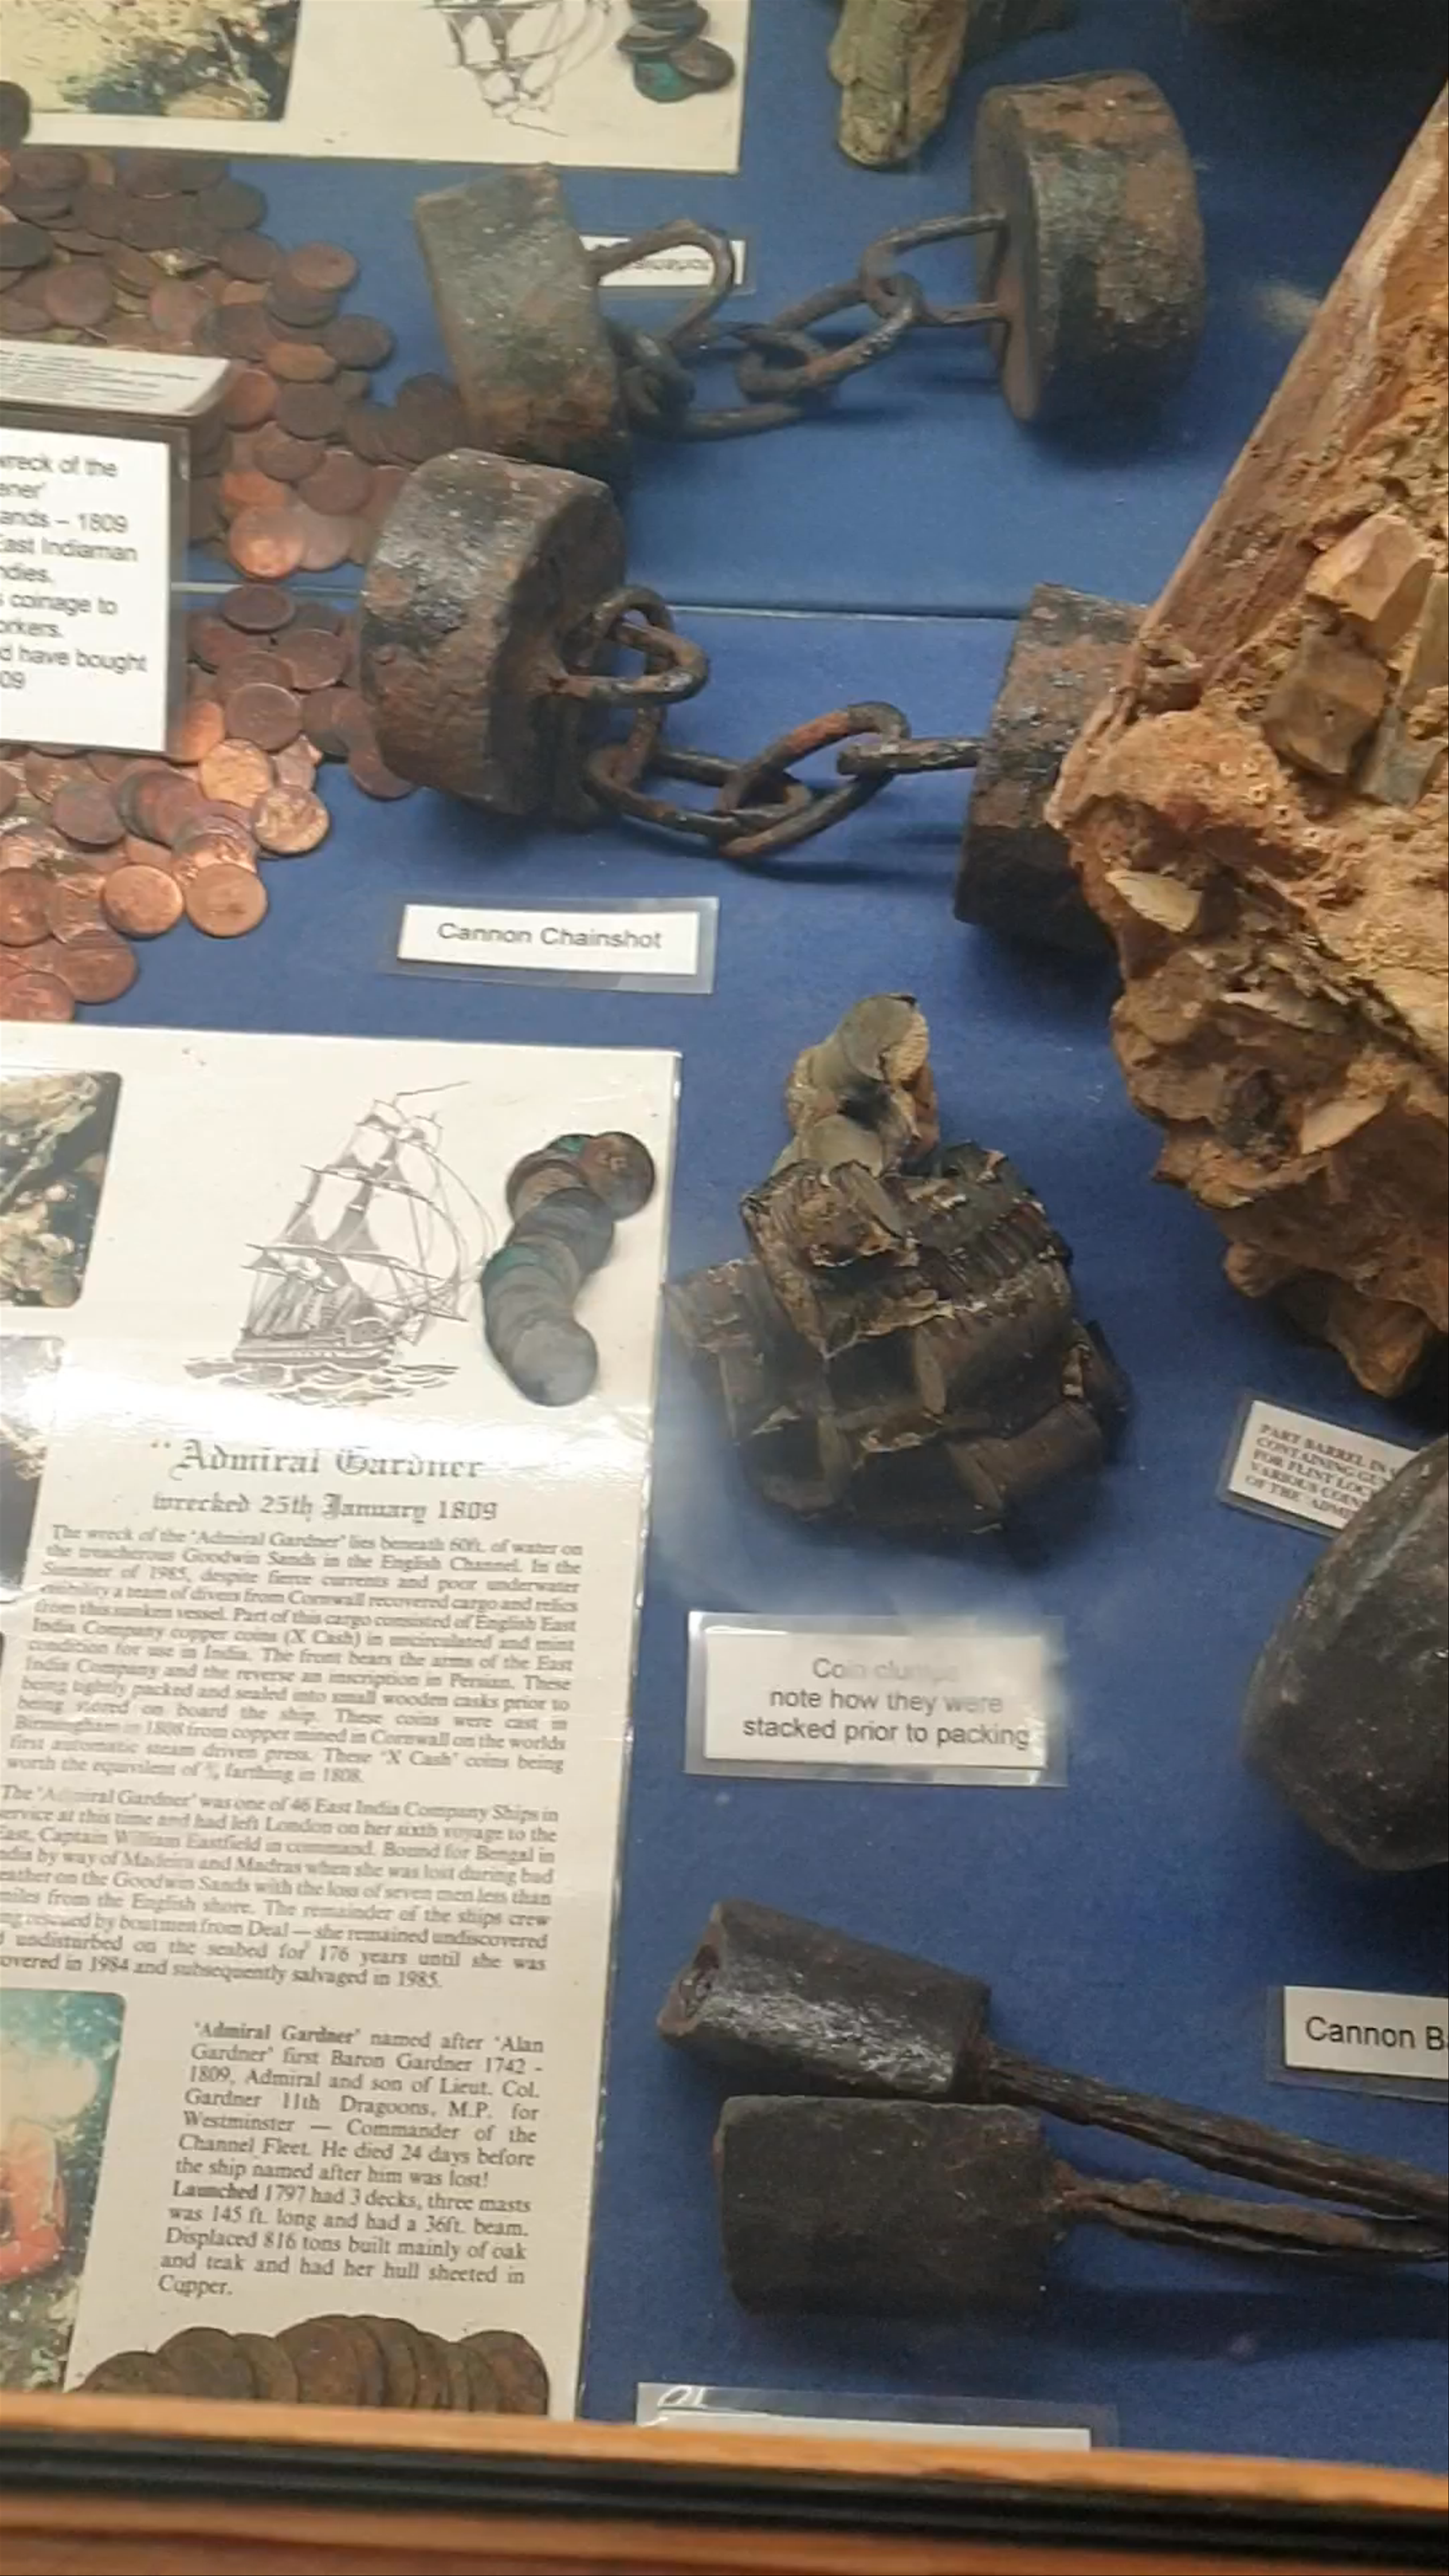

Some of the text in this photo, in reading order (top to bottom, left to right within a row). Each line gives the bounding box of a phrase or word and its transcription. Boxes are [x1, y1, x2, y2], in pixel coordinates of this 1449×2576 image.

[58, 455, 80, 475] of
[84, 457, 118, 477] the
[77, 513, 129, 533] 1809
[41, 537, 139, 561] Indiaman
[10, 591, 91, 616] coinage
[98, 597, 118, 615] to
[19, 644, 70, 665] have
[76, 649, 148, 675] bought
[437, 923, 663, 949] Cannon Chainshot
[336, 1446, 486, 1477] Gardner
[153, 1492, 497, 1523] wrecked 25th January 1809
[770, 1688, 1004, 1717] note how they were
[743, 1716, 1030, 1751] stacked prior to packing
[321, 1747, 372, 1763] These
[168, 1938, 197, 1954] the
[357, 1950, 407, 1969] years
[471, 1952, 502, 1968] she
[513, 1957, 546, 1970] was
[133, 1958, 168, 1974] and
[291, 1965, 368, 1988] salvaged
[373, 1970, 391, 1984] in
[371, 2030, 431, 2048] named
[440, 2033, 484, 2051] after
[1305, 2016, 1415, 2049] Cannon
[282, 2048, 319, 2065] first
[331, 2050, 385, 2068] Baron
[396, 2053, 474, 2073] Gardner
[244, 2069, 321, 2088] Admiral
[329, 2073, 364, 2090] and
[370, 2079, 402, 2092] son
[411, 2077, 433, 2094] of
[502, 2081, 539, 2099] Col.
[185, 2088, 262, 2108] Gardner
[512, 2104, 539, 2121] for
[183, 2111, 294, 2132] Westminster
[347, 2119, 460, 2140] Commander
[475, 2125, 496, 2142] of
[509, 2127, 536, 2144] the
[178, 2134, 535, 2168] Channel Fleet. He died 24 days before
[176, 2157, 488, 2188] the ship named after him was lost!
[312, 2187, 345, 2205] had
[365, 2190, 423, 2209] decks,
[428, 2193, 474, 2211] three
[478, 2198, 531, 2214] masts
[168, 2208, 203, 2222] was
[212, 2206, 241, 2223] 145
[247, 2208, 268, 2225] ft.
[277, 2209, 316, 2232] long
[323, 2212, 358, 2229] and
[365, 2213, 400, 2231] had
[407, 2219, 417, 2232] a
[474, 2219, 528, 2237] beam.
[165, 2228, 527, 2262] Displaced 816 tons built mainly of oak
[161, 2252, 525, 2285] and teak and had her hull sheeted in
